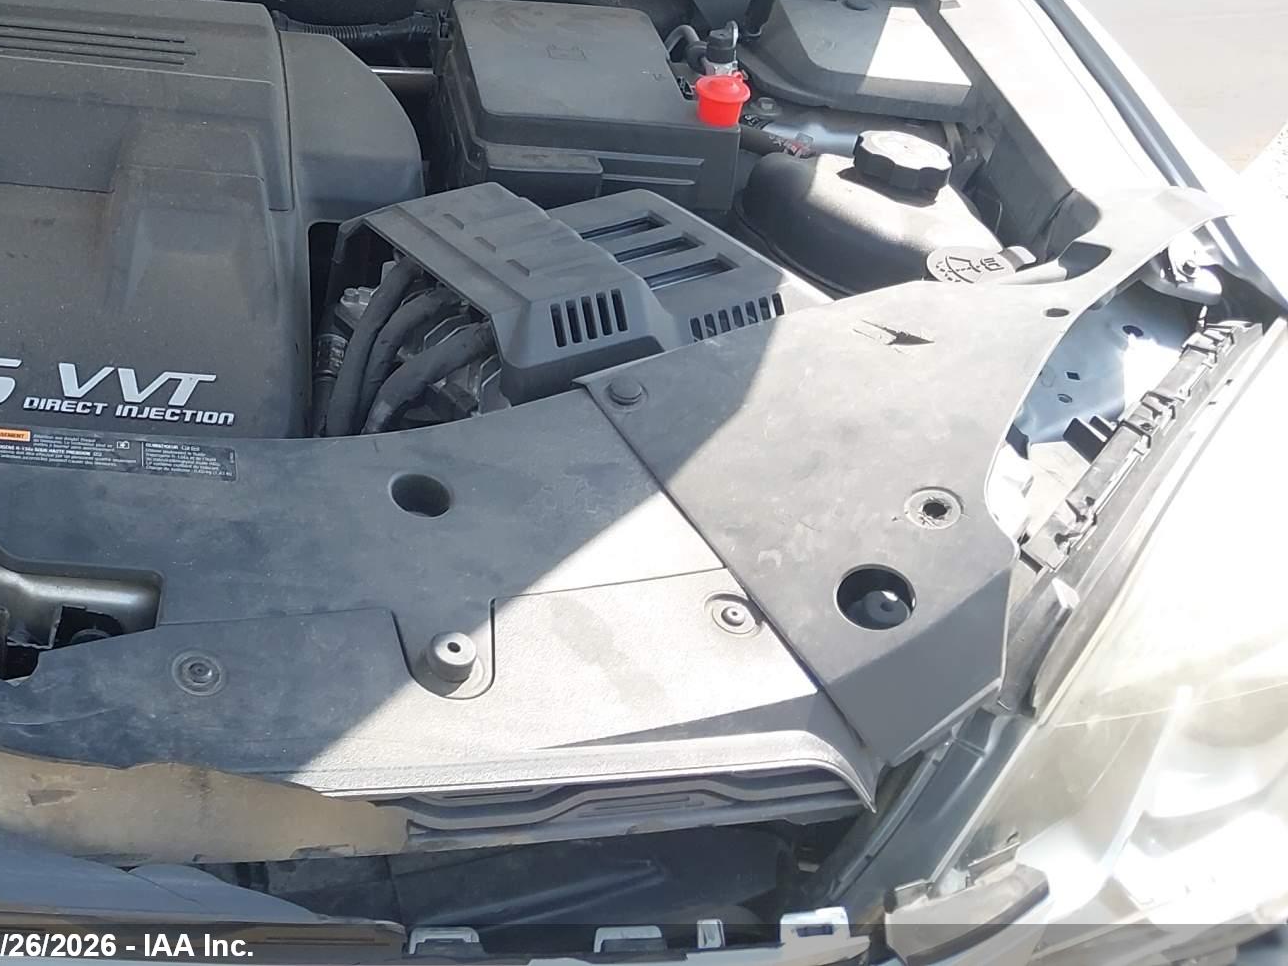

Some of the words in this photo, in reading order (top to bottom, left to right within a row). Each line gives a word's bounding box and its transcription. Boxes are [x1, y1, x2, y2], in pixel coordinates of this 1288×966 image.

[58, 362, 218, 408] VVT
[23, 396, 108, 416] DIRECT
[114, 400, 235, 425] INJECTION
